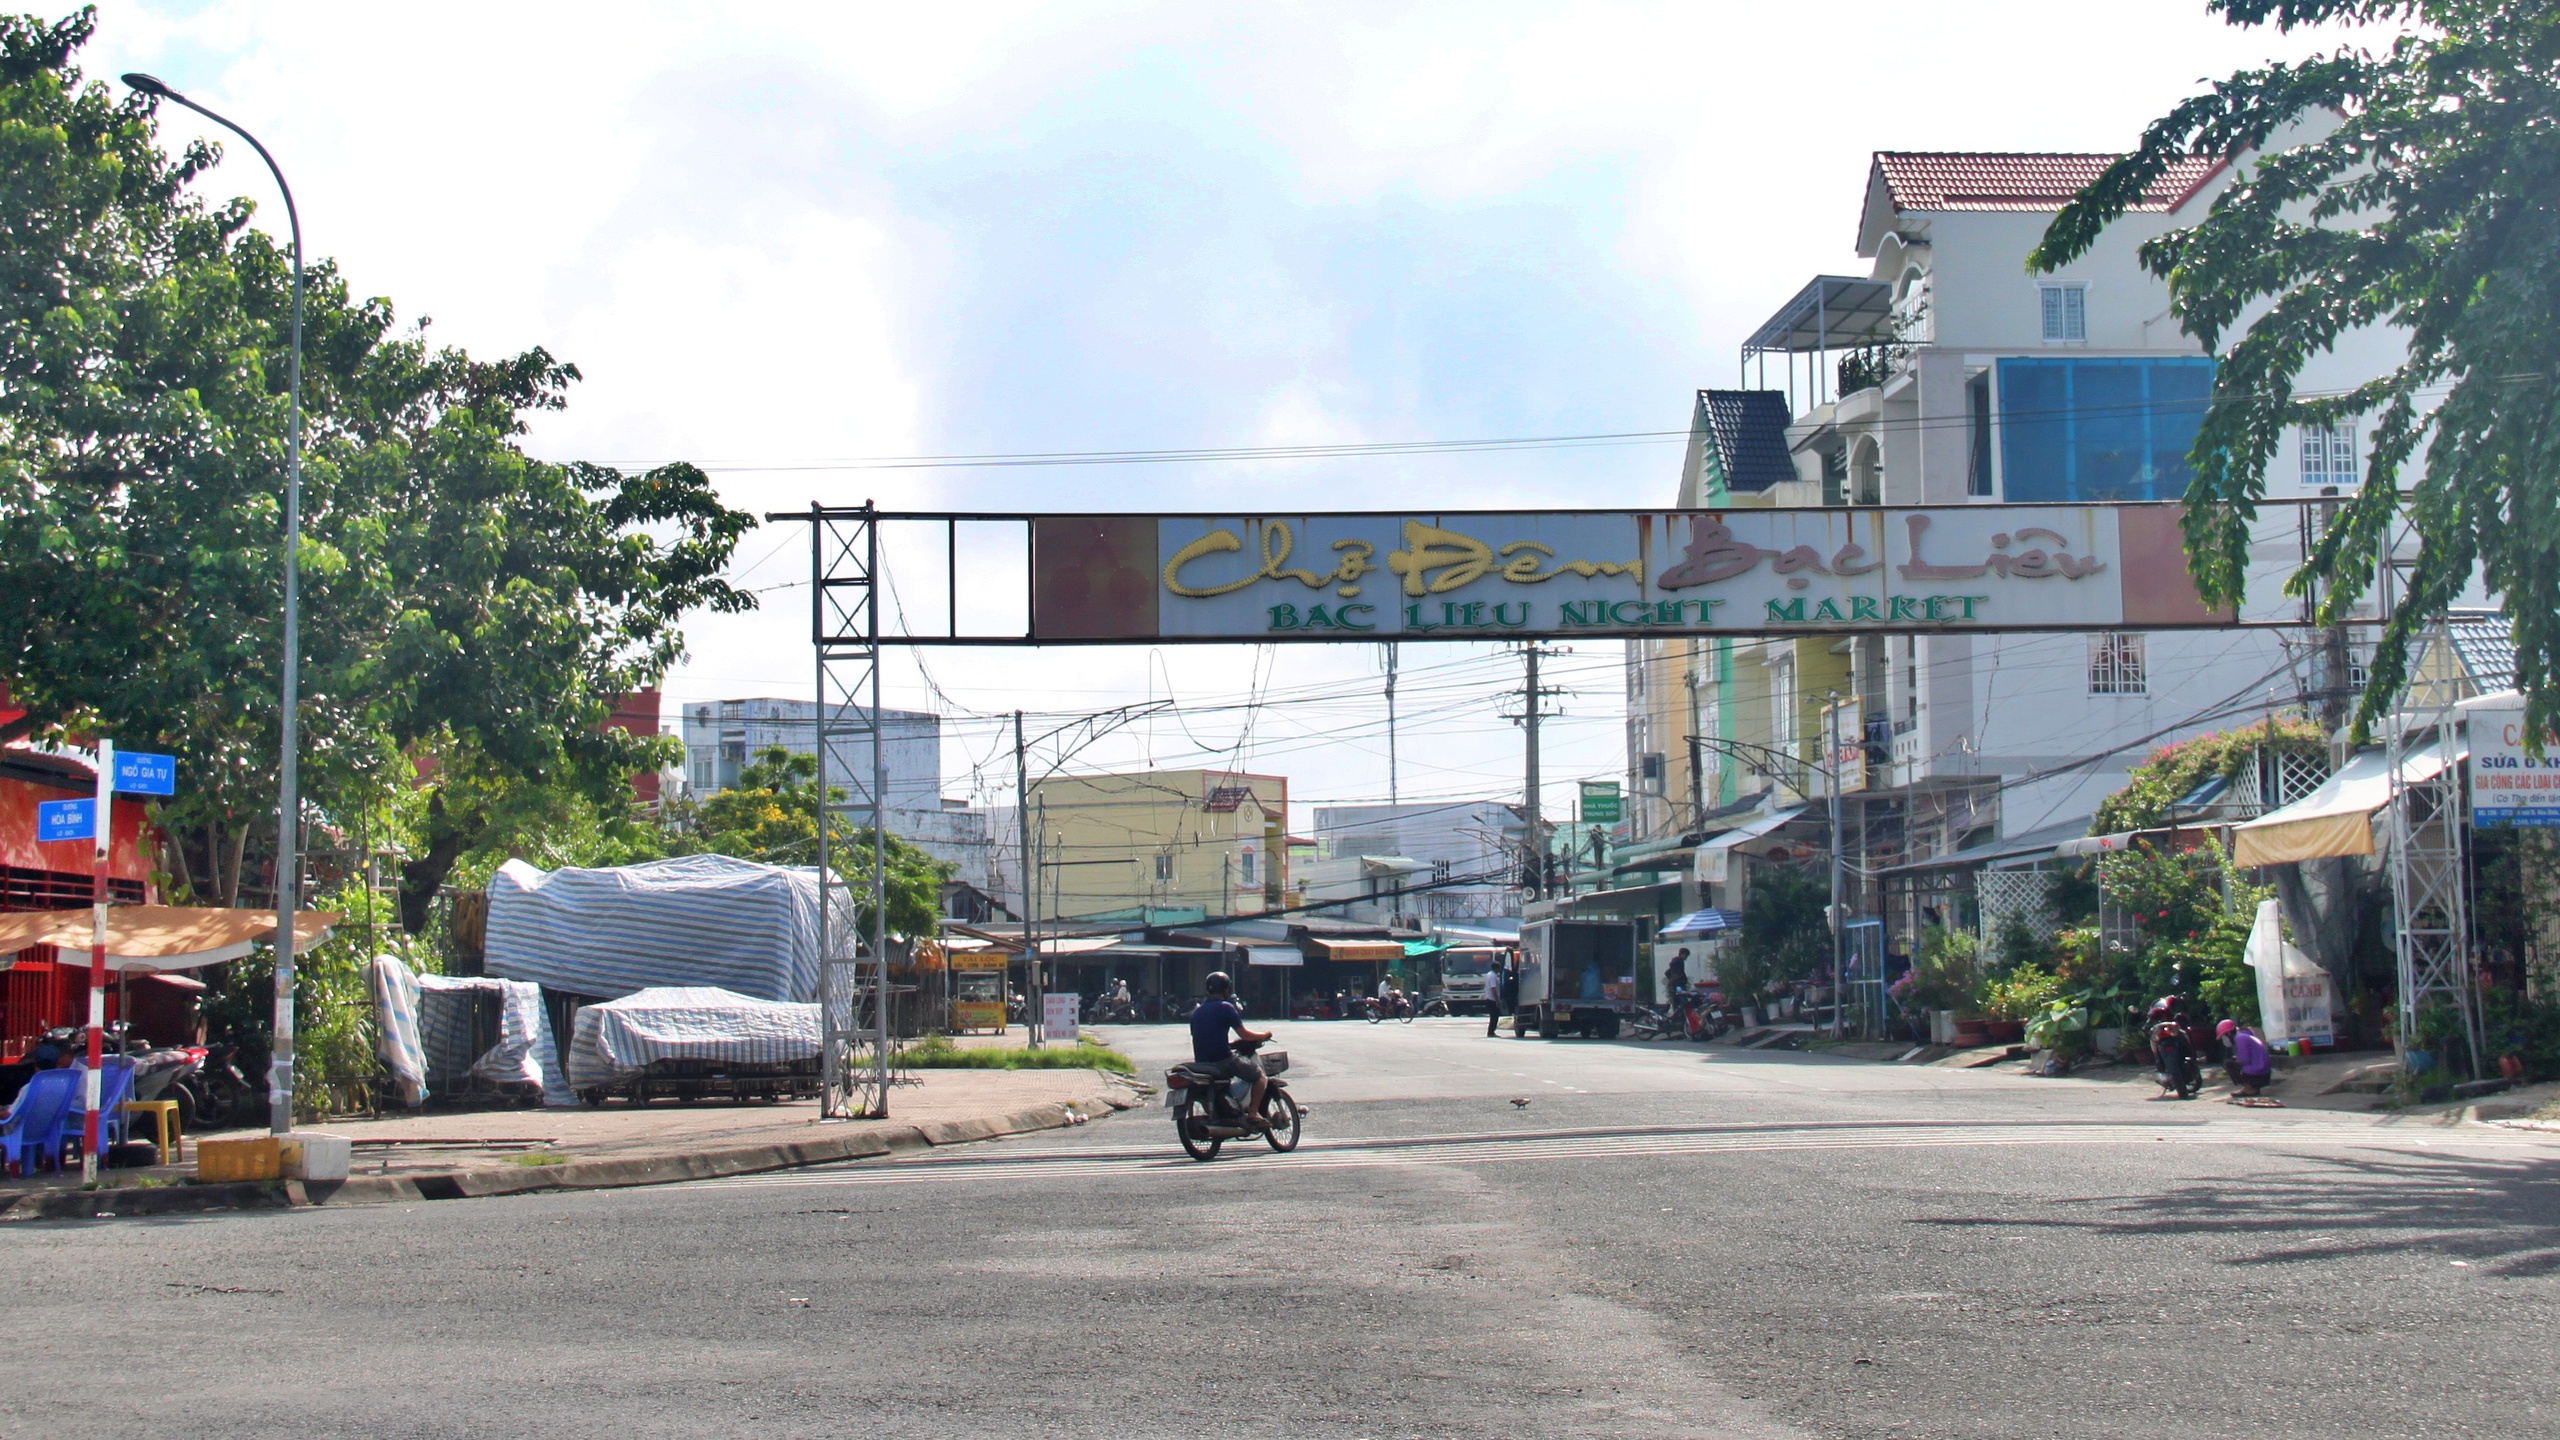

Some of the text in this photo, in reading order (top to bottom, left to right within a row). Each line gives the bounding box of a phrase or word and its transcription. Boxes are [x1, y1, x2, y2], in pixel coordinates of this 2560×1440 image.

[1163, 514, 2107, 598] Chợ Đêm Bạc Liêu
[1268, 595, 1989, 632] BAC LIEU NIGHT MARKET
[2481, 752, 2518, 768] SỬA
[141, 767, 155, 778] GIA
[2475, 775, 2489, 789] GIA
[2491, 773, 2512, 789] CÔNG
[2515, 772, 2531, 789] CÁC
[2534, 774, 2551, 792] LOẠI
